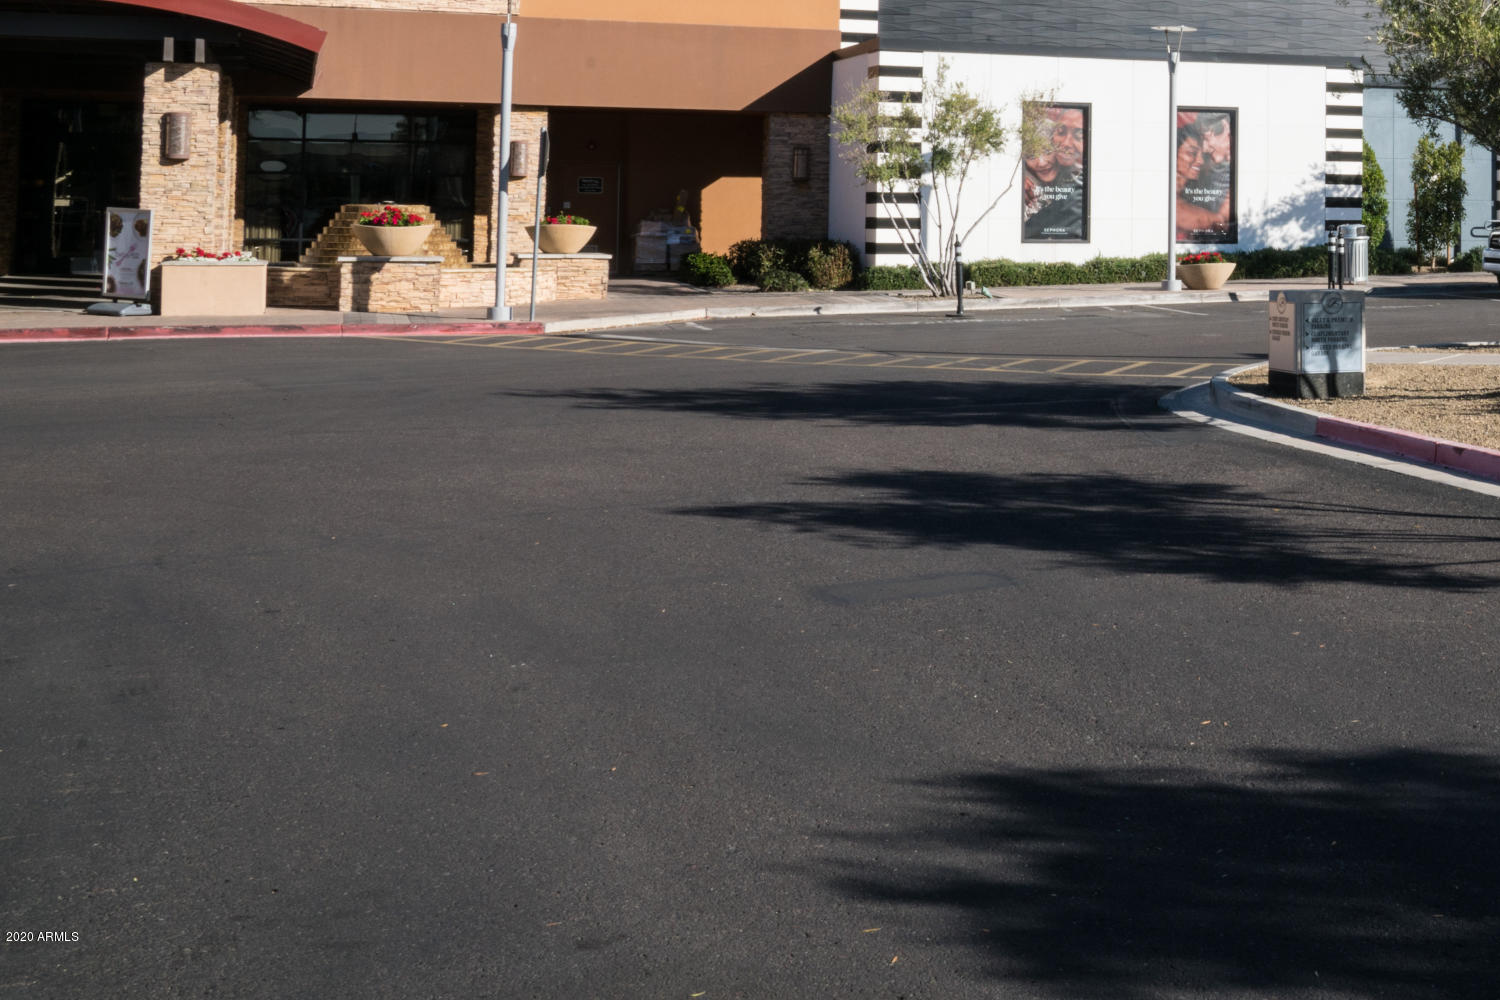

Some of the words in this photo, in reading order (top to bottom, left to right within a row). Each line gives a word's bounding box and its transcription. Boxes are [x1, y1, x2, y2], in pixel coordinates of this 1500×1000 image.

[1044, 185, 1055, 194] the
[1055, 185, 1075, 195] beauty
[1193, 187, 1203, 195] the
[1203, 187, 1223, 196] beauty
[1055, 192, 1069, 201] give
